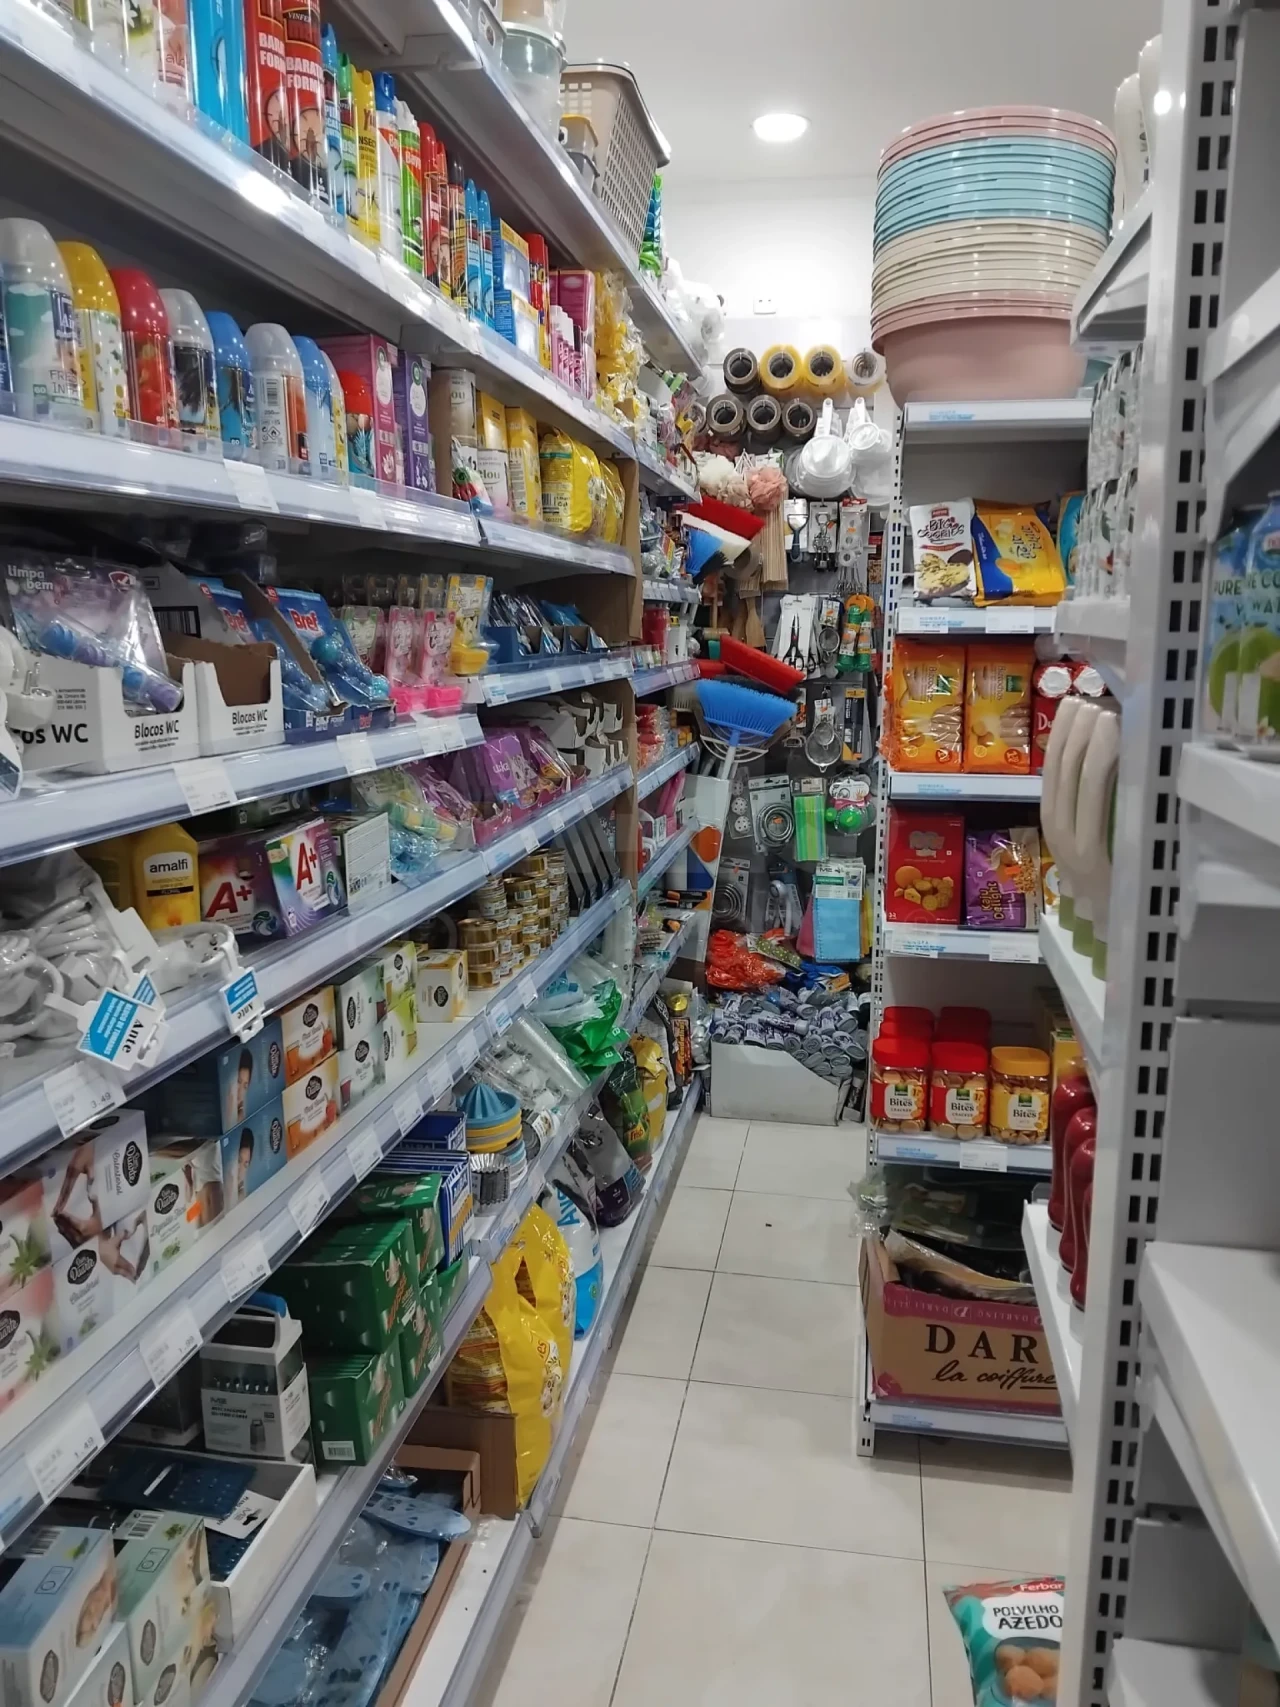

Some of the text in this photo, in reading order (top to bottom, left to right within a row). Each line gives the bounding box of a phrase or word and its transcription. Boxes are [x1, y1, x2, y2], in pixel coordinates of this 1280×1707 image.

[7, 564, 45, 579] Limpa
[26, 575, 54, 591] bem
[291, 609, 319, 632] Bref
[232, 709, 268, 725] Blocos WC
[51, 723, 89, 744] WC
[134, 720, 179, 739] Blocos WC
[149, 859, 189, 873] amalfi
[296, 843, 318, 891] A+
[205, 881, 253, 918] A+
[988, 881, 1005, 921] Delight
[122, 1019, 144, 1054] Ante
[91, 1091, 112, 1110] 3.49
[889, 1097, 913, 1107] Bites
[950, 1102, 975, 1112] Bites
[1012, 1109, 1037, 1119] Bites
[126, 1144, 136, 1185] Duarte
[69, 1257, 95, 1281] Duarte
[924, 1323, 1039, 1365] DAR
[932, 1359, 1057, 1390] la coiffure
[1019, 1583, 1063, 1592] Ferbar
[993, 1604, 1059, 1618] POLVILHO
[998, 1615, 1063, 1630] AZEDO
